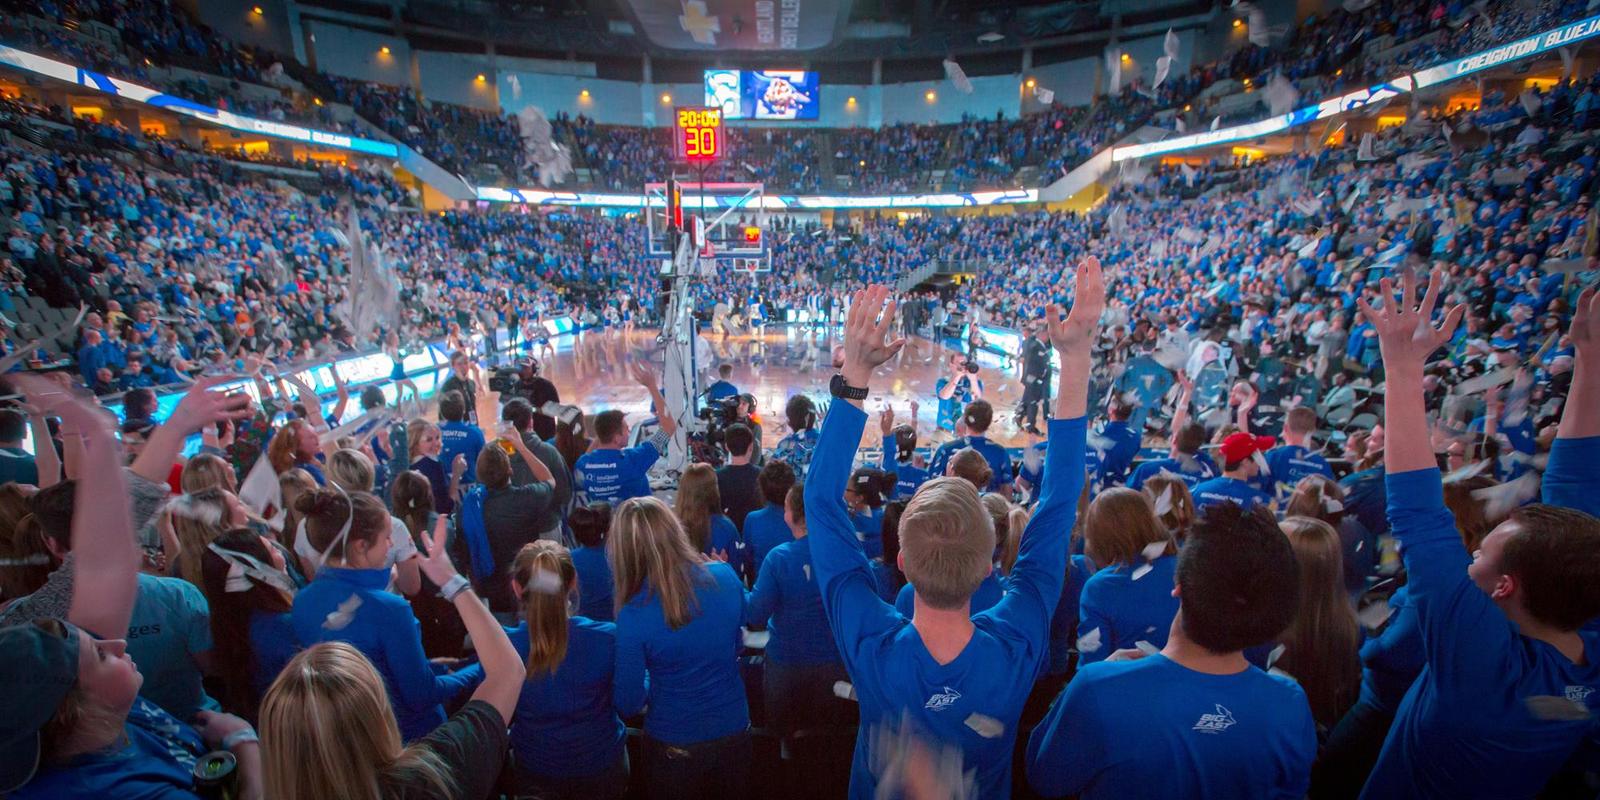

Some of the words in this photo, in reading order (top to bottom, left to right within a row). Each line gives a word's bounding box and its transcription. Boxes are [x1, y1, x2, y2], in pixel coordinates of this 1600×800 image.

[1456, 37, 1541, 74] CREIGHTON
[686, 128, 714, 155] 30
[1192, 719, 1229, 730] EAST
[1200, 713, 1226, 721] BIG
